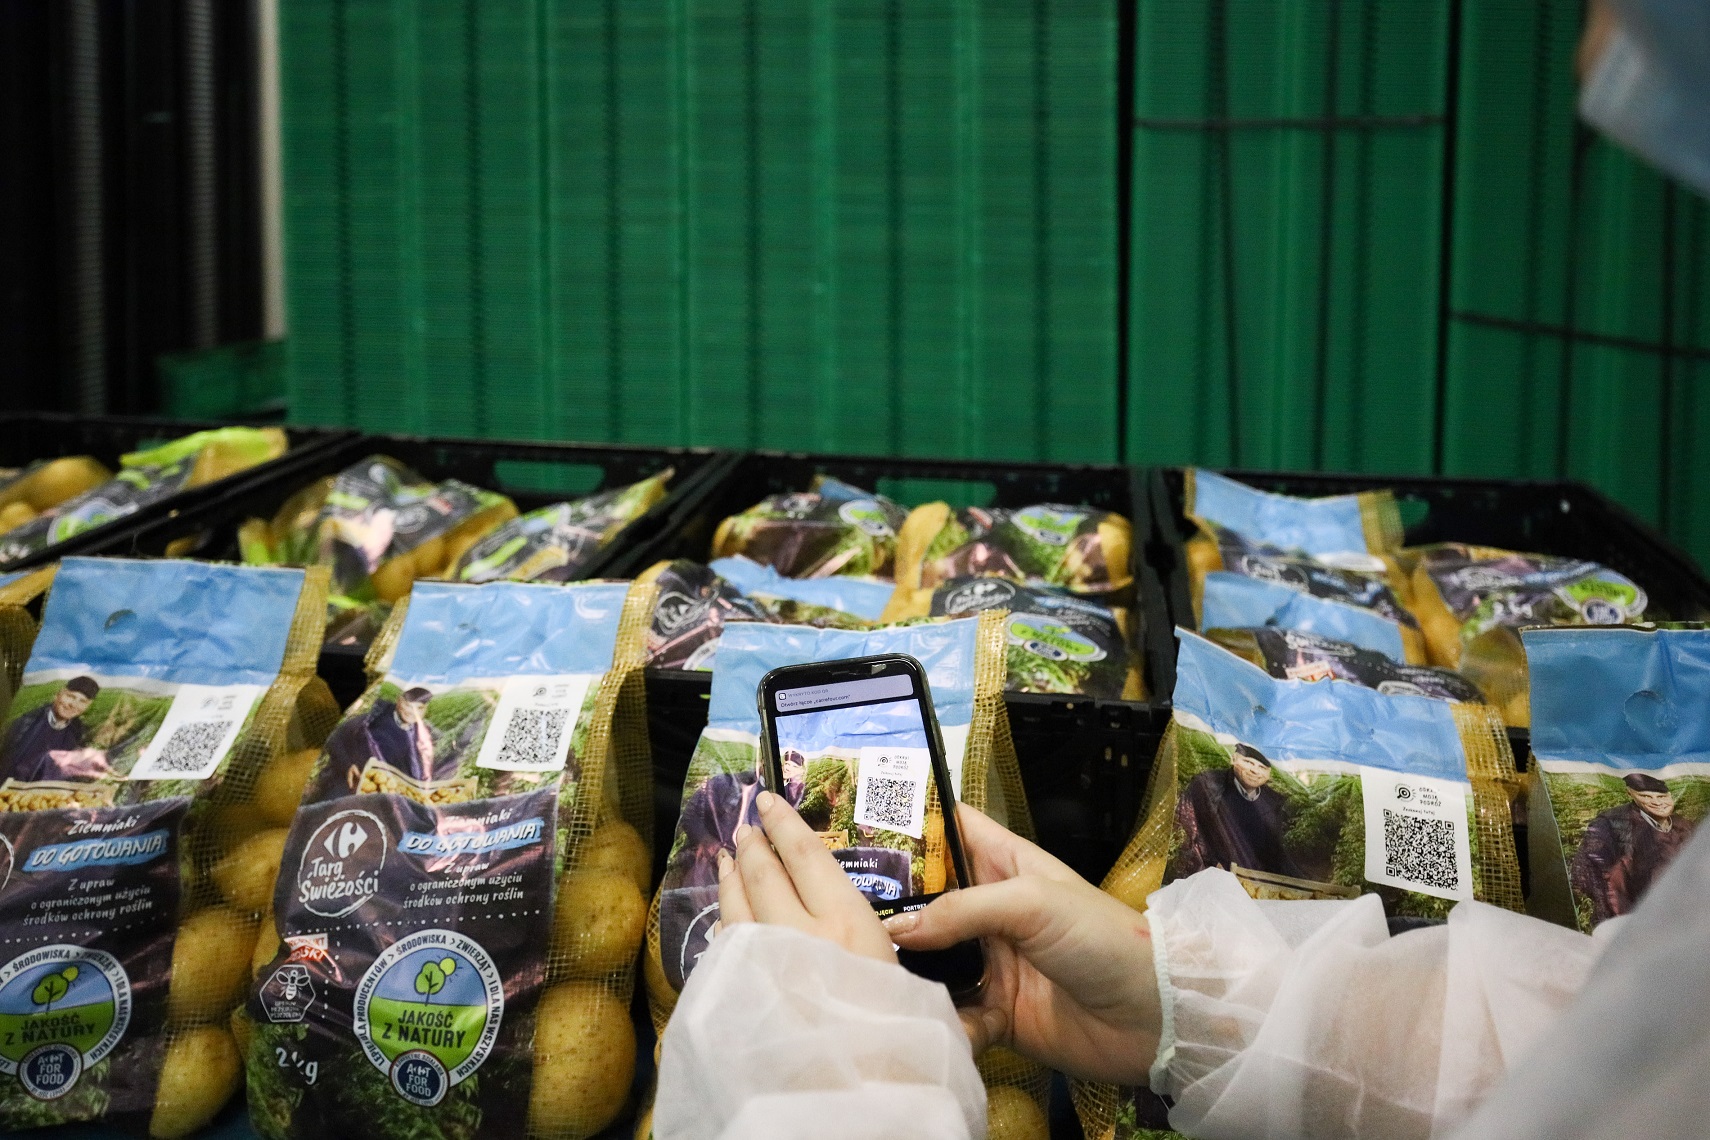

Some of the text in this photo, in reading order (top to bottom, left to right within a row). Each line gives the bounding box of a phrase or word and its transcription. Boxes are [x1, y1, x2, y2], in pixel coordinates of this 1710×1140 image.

[67, 815, 141, 836] Ziemniaki
[406, 822, 536, 853] DO GOTOWANIA
[32, 834, 163, 867] DO GOTOWANIA
[311, 856, 344, 881] Targ
[444, 862, 490, 876] Z upraw
[68, 878, 116, 893] Z upraw
[298, 870, 379, 903] Świeżości
[410, 872, 522, 894] o ograniczonym użyciu
[31, 885, 151, 912] o ograniczonym użyciu
[403, 887, 524, 908] środków ochrony roślin
[23, 900, 154, 926] środków ochrony roślin
[397, 934, 446, 955] ŚRODOWISKA
[12, 950, 70, 972] ŚRODOWISKA
[456, 939, 492, 973] ZWIERZĄT
[357, 961, 388, 1022] PRODUCENTÓW
[490, 986, 500, 1004] DLA
[21, 1013, 81, 1031] JAKOŚĆ
[398, 1009, 454, 1029] JAKOŚĆ
[492, 1006, 501, 1026] NAS
[5, 1023, 96, 1046] Z NATURY
[382, 1022, 466, 1049] Z NATURY
[456, 1026, 496, 1077] WSZYSTKICH
[40, 1063, 62, 1074] FOR
[36, 1074, 64, 1086] FOOD
[406, 1082, 432, 1097] FOOD
[408, 1074, 428, 1087] FOR
